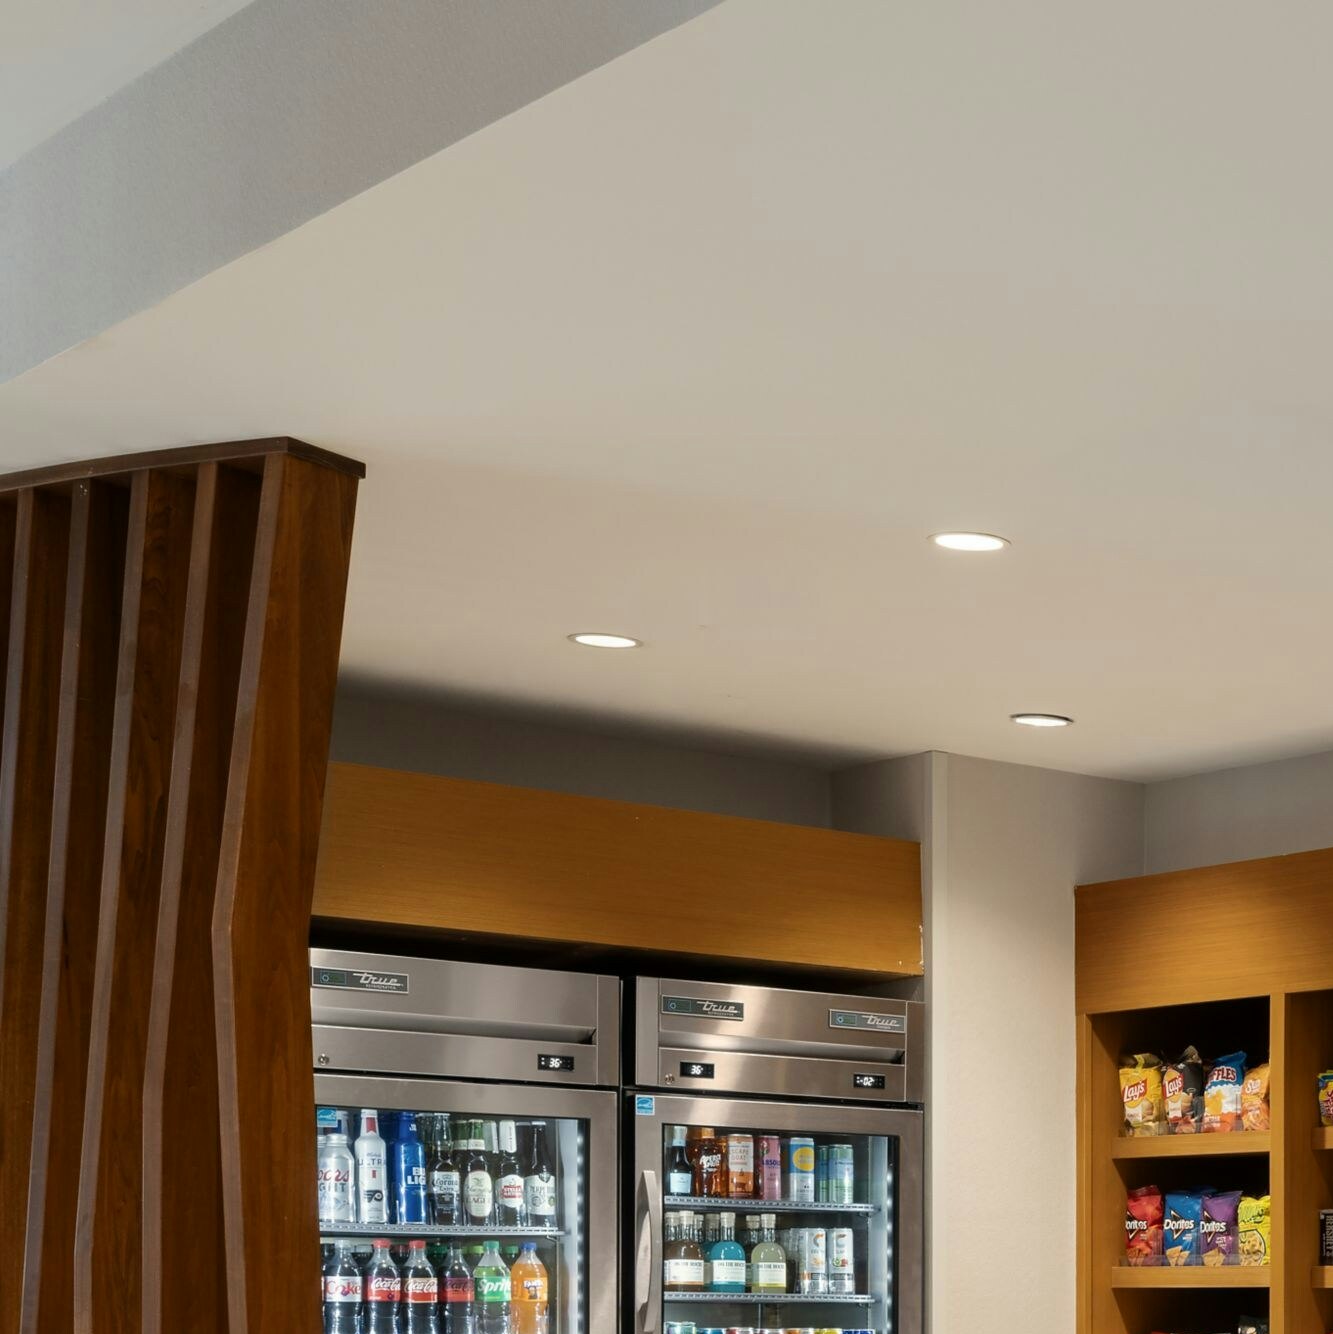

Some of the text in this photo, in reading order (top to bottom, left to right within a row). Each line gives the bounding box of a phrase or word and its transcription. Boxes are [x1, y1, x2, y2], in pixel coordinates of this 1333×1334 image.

[1124, 1081, 1145, 1102] Lay's
[1165, 1076, 1183, 1098] Lay's
[406, 1176, 426, 1185] LIG
[1125, 1220, 1148, 1230] oritos
[1164, 1219, 1194, 1231] Doritos
